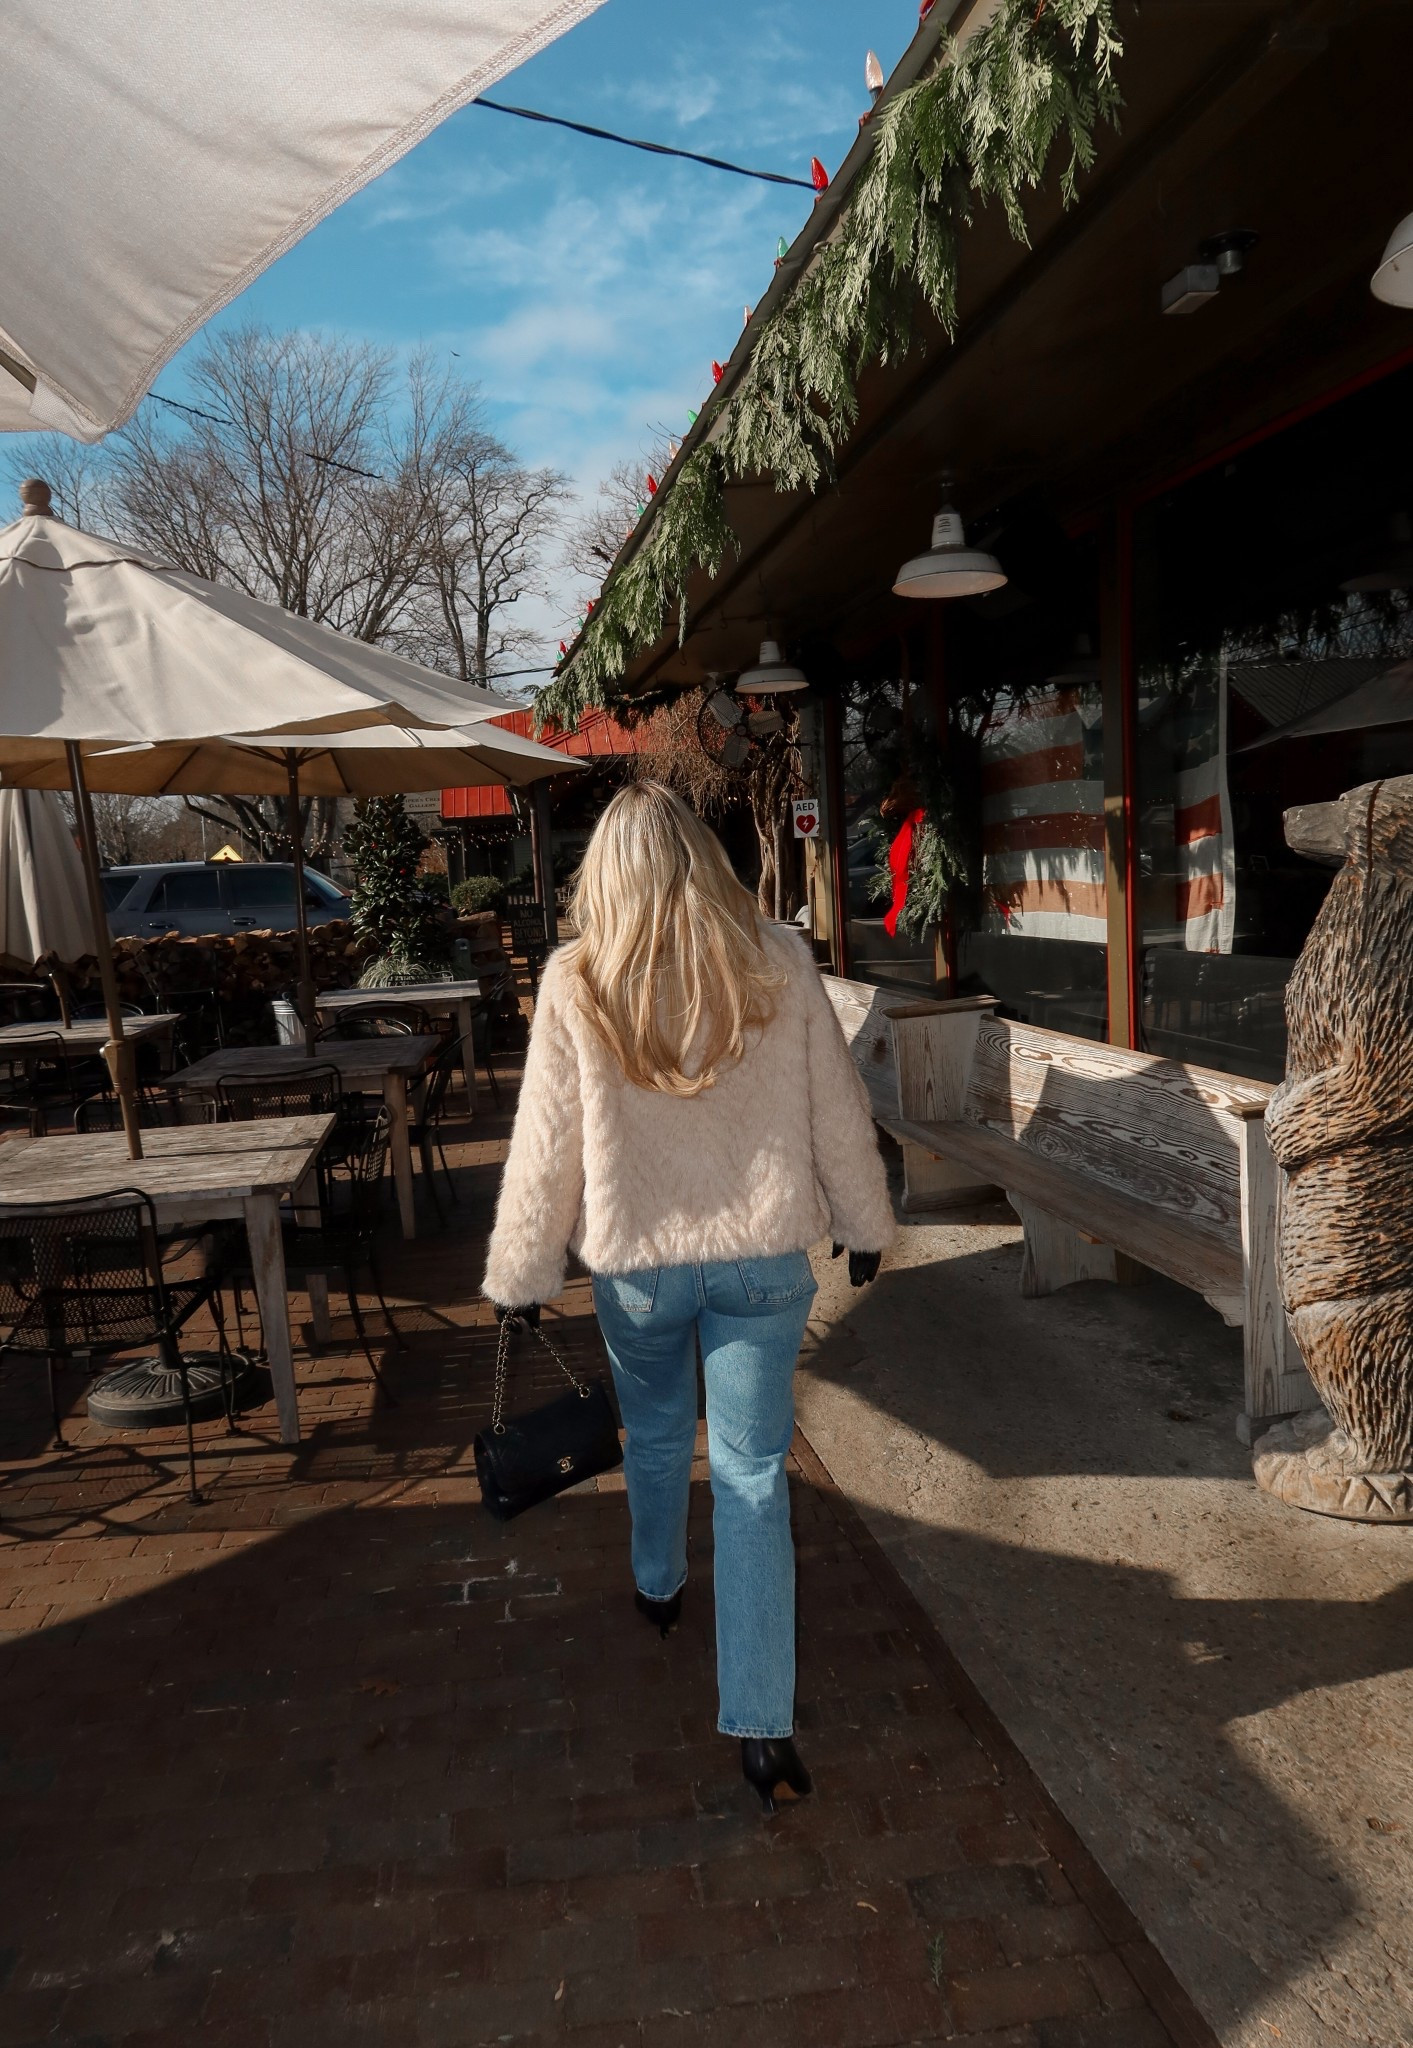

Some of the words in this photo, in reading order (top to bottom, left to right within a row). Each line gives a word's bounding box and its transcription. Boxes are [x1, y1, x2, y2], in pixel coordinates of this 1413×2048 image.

[795, 802, 815, 812] AED
[520, 909, 534, 918] NO
[513, 918, 543, 927] ALCOHOL
[514, 927, 544, 939] BEYOND
